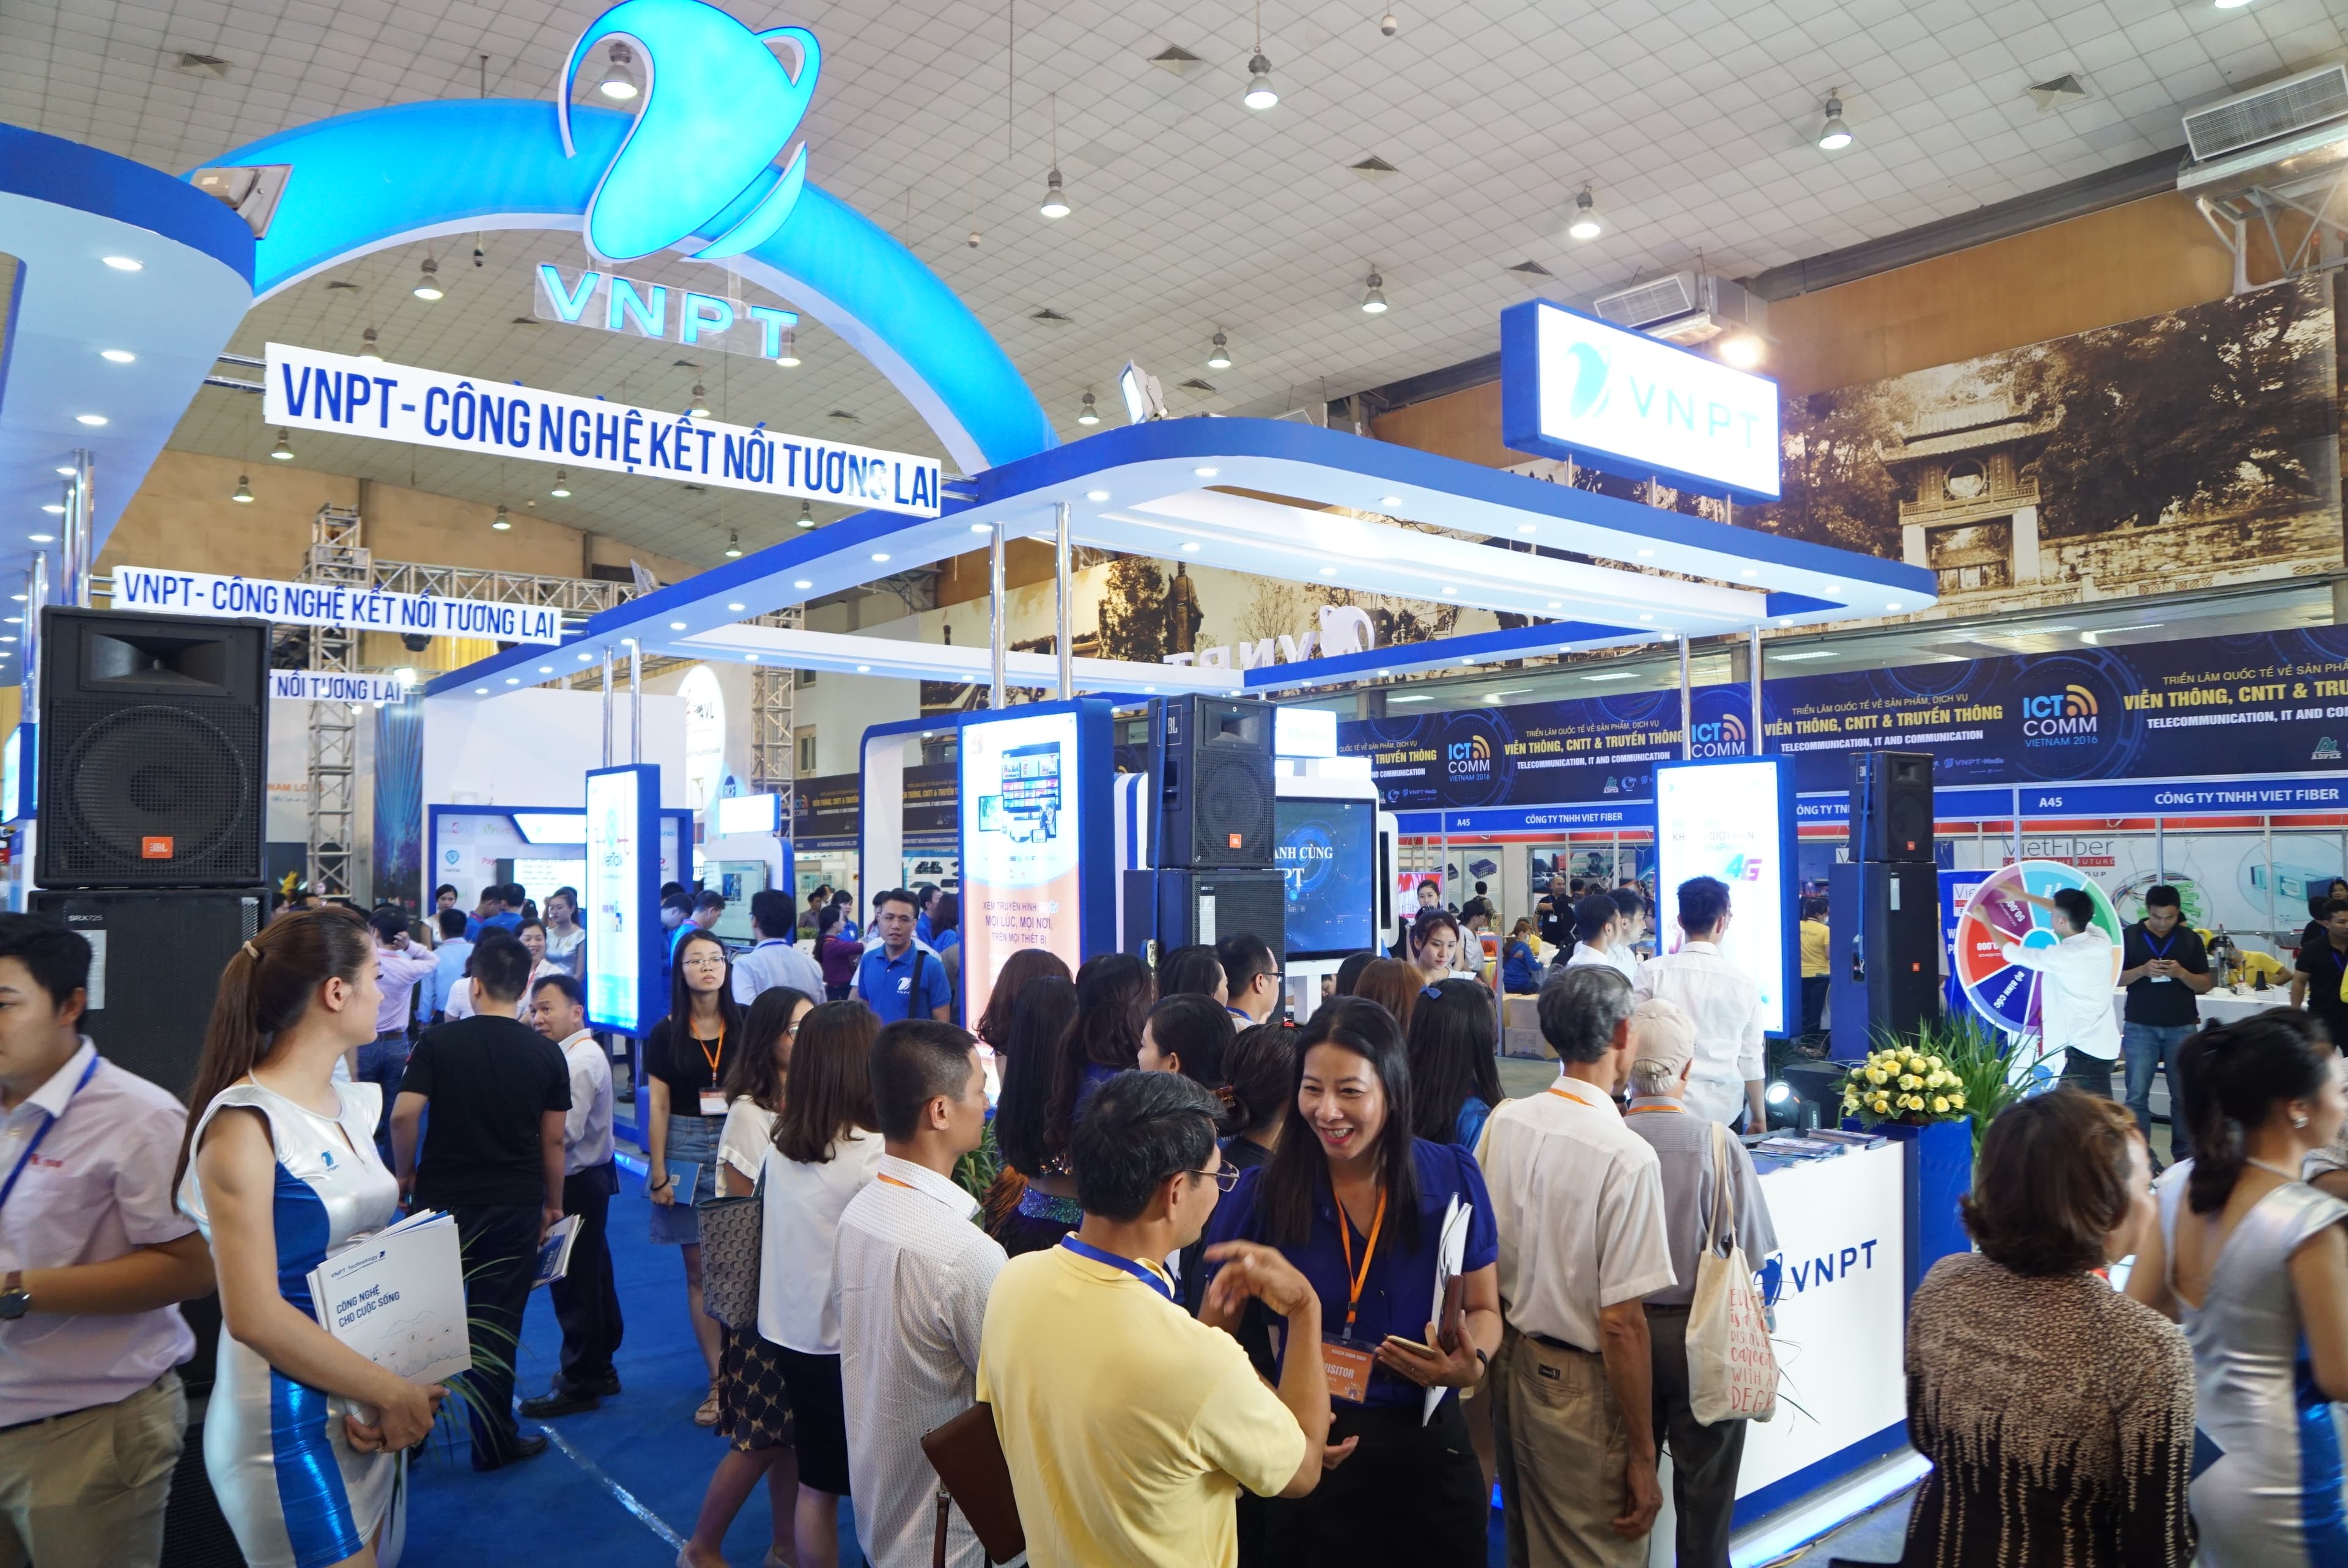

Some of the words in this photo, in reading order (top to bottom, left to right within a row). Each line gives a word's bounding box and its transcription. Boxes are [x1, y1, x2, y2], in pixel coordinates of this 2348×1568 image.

[539, 263, 799, 358] VNPT
[1628, 375, 1760, 449] VNPT
[424, 381, 531, 447] CÔNG
[539, 407, 644, 473] NGHỆ
[649, 409, 718, 475] KẾT
[723, 421, 775, 484] NỐI
[783, 443, 887, 500] TƯƠNG
[894, 462, 938, 509] LAI
[213, 575, 278, 614] CÔNG
[284, 582, 345, 627] NGHỆ
[352, 583, 396, 625] KẾT
[402, 589, 437, 629] NỐI
[443, 602, 514, 635] TƯƠNG
[522, 609, 554, 638] LAI
[2223, 668, 2256, 681] QUỐC
[2259, 664, 2274, 677] TẾ
[2296, 662, 2321, 675] SẢN
[277, 668, 306, 698] NỐI
[310, 677, 367, 701] TƯƠNG
[373, 680, 400, 702] LAI
[1834, 702, 1858, 712] QUỐC
[1859, 699, 1870, 710] TẾ
[1955, 693, 1968, 703] VỤ
[2123, 689, 2163, 710] VIỄN
[2168, 687, 2234, 708] THÔNG,
[2239, 683, 2287, 702] CNTT
[2292, 683, 2308, 699] &
[2314, 680, 2348, 697] TRU
[2022, 696, 2064, 719] ICT
[1167, 716, 1179, 734] BL
[1764, 718, 1793, 737] VIỄN
[1796, 716, 1842, 734] THÔNG,
[1845, 714, 1879, 731] CNTT
[1882, 714, 1893, 727] &
[1896, 705, 1951, 727] TRUYỀN
[1954, 704, 2004, 723] THÔNG
[2022, 716, 2098, 737] COMM
[2147, 711, 2278, 729] TELECOMMUNICATION,
[2281, 710, 2292, 721] IT
[2295, 708, 2323, 720] AND
[1559, 726, 1576, 735] QUỐC
[1691, 722, 1721, 743] ICT
[1504, 740, 1527, 756] VIỄN
[1529, 738, 1563, 754] THÔNG,
[1566, 737, 1592, 751] CNTT
[1594, 737, 1602, 749] &
[1605, 731, 1647, 748] TRUYỀN
[1648, 729, 1683, 744] THÔNG
[1691, 741, 1746, 758] COMM
[1781, 737, 1873, 753] TELECOMMUNICATION,
[1874, 737, 1883, 746] IT
[1884, 735, 1903, 745] AND
[1905, 729, 1984, 744] COMMUNICATION
[2025, 737, 2071, 748] VIETNAM
[2073, 735, 2099, 745] 2016
[1375, 749, 1407, 765] TRUYỀN
[1408, 748, 1437, 762] THÔNG
[1448, 742, 1472, 760] ICT
[1516, 757, 1587, 770] TELECOMMUNICATION,
[1588, 756, 1595, 765] IT
[1596, 756, 1610, 764] AND
[1611, 751, 1671, 764] COMMUNICATION
[1379, 768, 1426, 778] COMMUNICATION
[1448, 759, 1490, 773] COMM
[2039, 797, 2063, 808] A45
[2154, 791, 2195, 804] CÔNG
[2196, 792, 2212, 803] TY
[2215, 791, 2258, 803] TNHH
[2259, 789, 2293, 802] VIET
[2295, 788, 2339, 801] FIBER
[1525, 814, 1548, 825] CÔNG
[1548, 814, 1557, 823] TY
[1559, 814, 1581, 823] TNHH
[1582, 813, 1599, 822] VIET
[1600, 812, 1623, 822] FIBER
[1796, 804, 1818, 815] ÔNG
[1820, 805, 1833, 814] TY
[1456, 818, 1471, 827] A45
[1299, 843, 1333, 859] CÙNG
[1284, 867, 1305, 887] PT
[1724, 853, 1763, 882] 4G
[983, 901, 995, 911] XEM
[1022, 900, 1037, 912] HÌNH
[985, 915, 999, 929] MỌI
[1000, 914, 1018, 930] LÚC,
[1020, 916, 1035, 931] MỌI
[1036, 917, 1054, 931] NƠI,
[1008, 933, 1020, 944] MỌI
[1021, 932, 1039, 943] THIẾT
[1039, 935, 1047, 946] BỊ
[2014, 970, 2026, 983] BỘ
[2003, 979, 2018, 996] BÌNH
[330, 1267, 346, 1279] VNPT
[347, 1254, 378, 1271] Technology
[1790, 1239, 1878, 1294] VNPT
[336, 1295, 358, 1315] CÔNG
[359, 1283, 381, 1302] NGHỆ
[338, 1312, 355, 1328] CHO
[356, 1300, 377, 1320] CUỘC
[377, 1290, 401, 1309] SỐNG
[1732, 1367, 1762, 1386] WITH
[1731, 1385, 1775, 1413] DEGR
